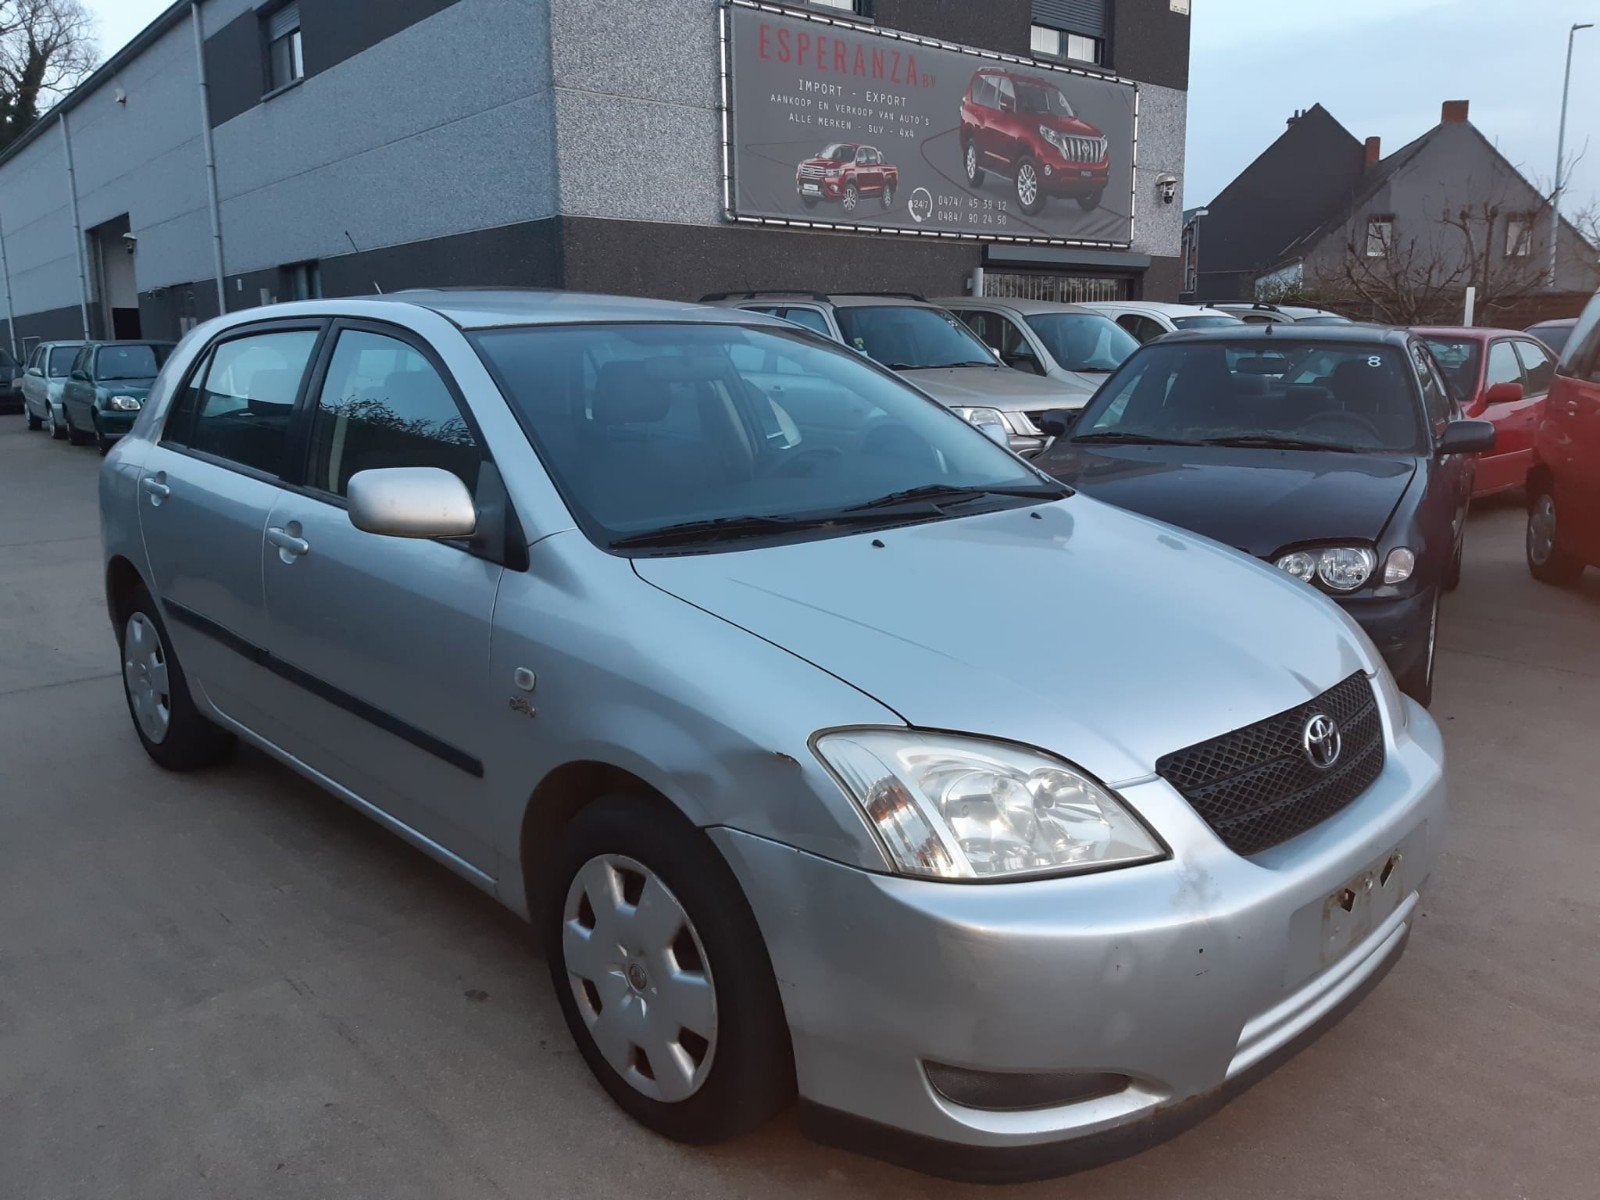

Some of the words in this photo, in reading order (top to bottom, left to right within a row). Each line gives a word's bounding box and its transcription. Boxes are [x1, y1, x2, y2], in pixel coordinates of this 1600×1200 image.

[759, 24, 917, 87] ESPERANZA
[799, 79, 842, 97] IMPORT
[866, 91, 907, 107] EXPORT
[770, 94, 812, 107] AANKOOP
[818, 101, 829, 111] EN
[835, 104, 873, 118] VERKOOP
[879, 110, 894, 121] VAN
[900, 113, 930, 126] AUTO'S
[788, 113, 812, 124] ALLE
[818, 117, 851, 130] MERKEN
[868, 124, 884, 134] SUV
[938, 195, 963, 207] 0474/
[969, 198, 978, 209] 45
[983, 199, 993, 210] 39
[998, 201, 1007, 211] 12
[938, 210, 963, 222] 0484/
[969, 213, 978, 224] 90
[1367, 355, 1381, 368] 8
